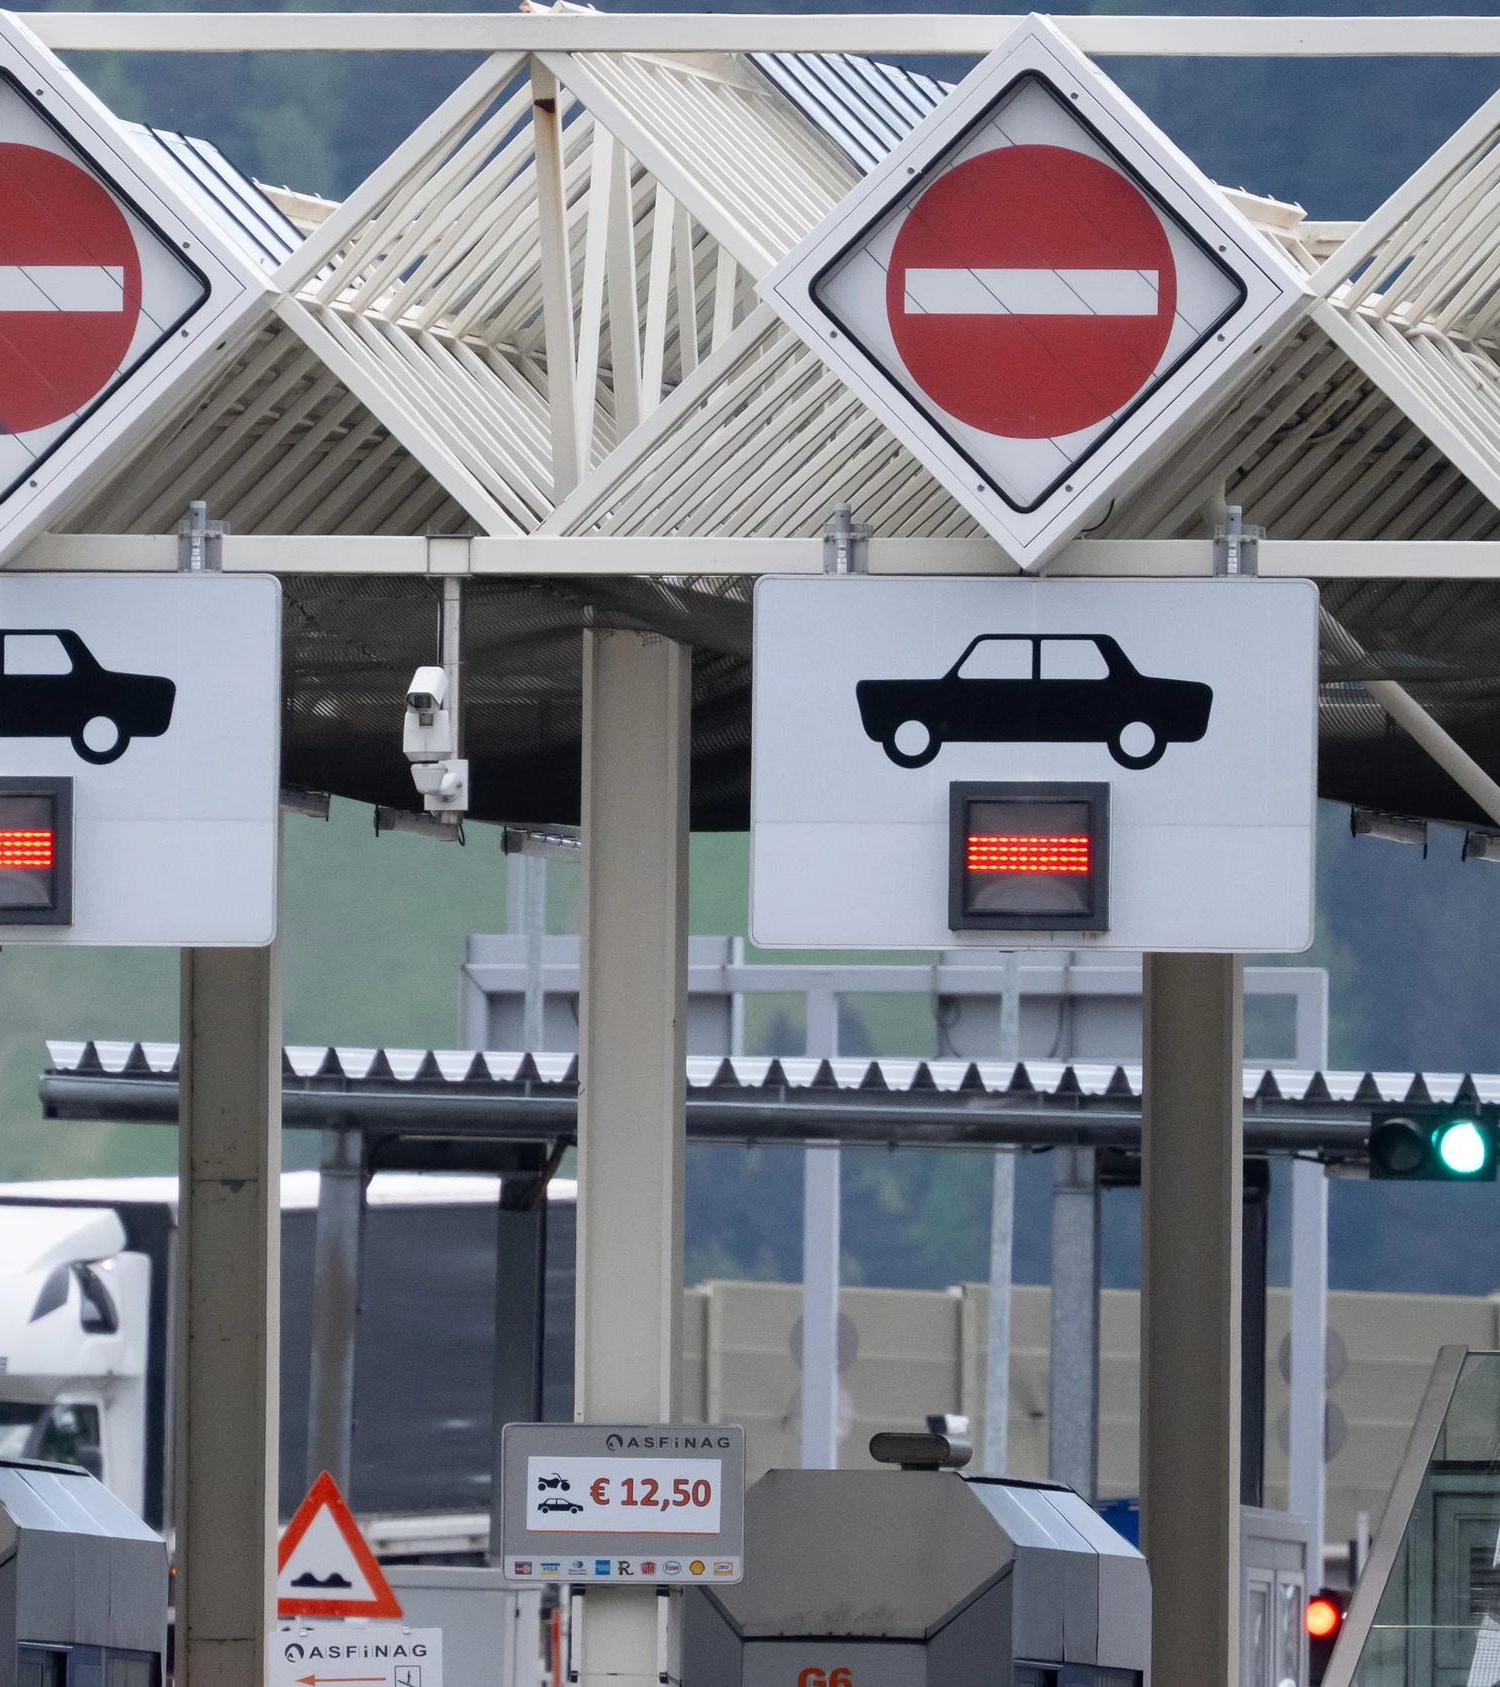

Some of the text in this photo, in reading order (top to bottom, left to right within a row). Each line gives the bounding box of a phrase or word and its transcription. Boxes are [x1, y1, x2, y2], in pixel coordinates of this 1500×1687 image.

[589, 1478, 712, 1512] € 12,50
[797, 1668, 853, 1687] G6
